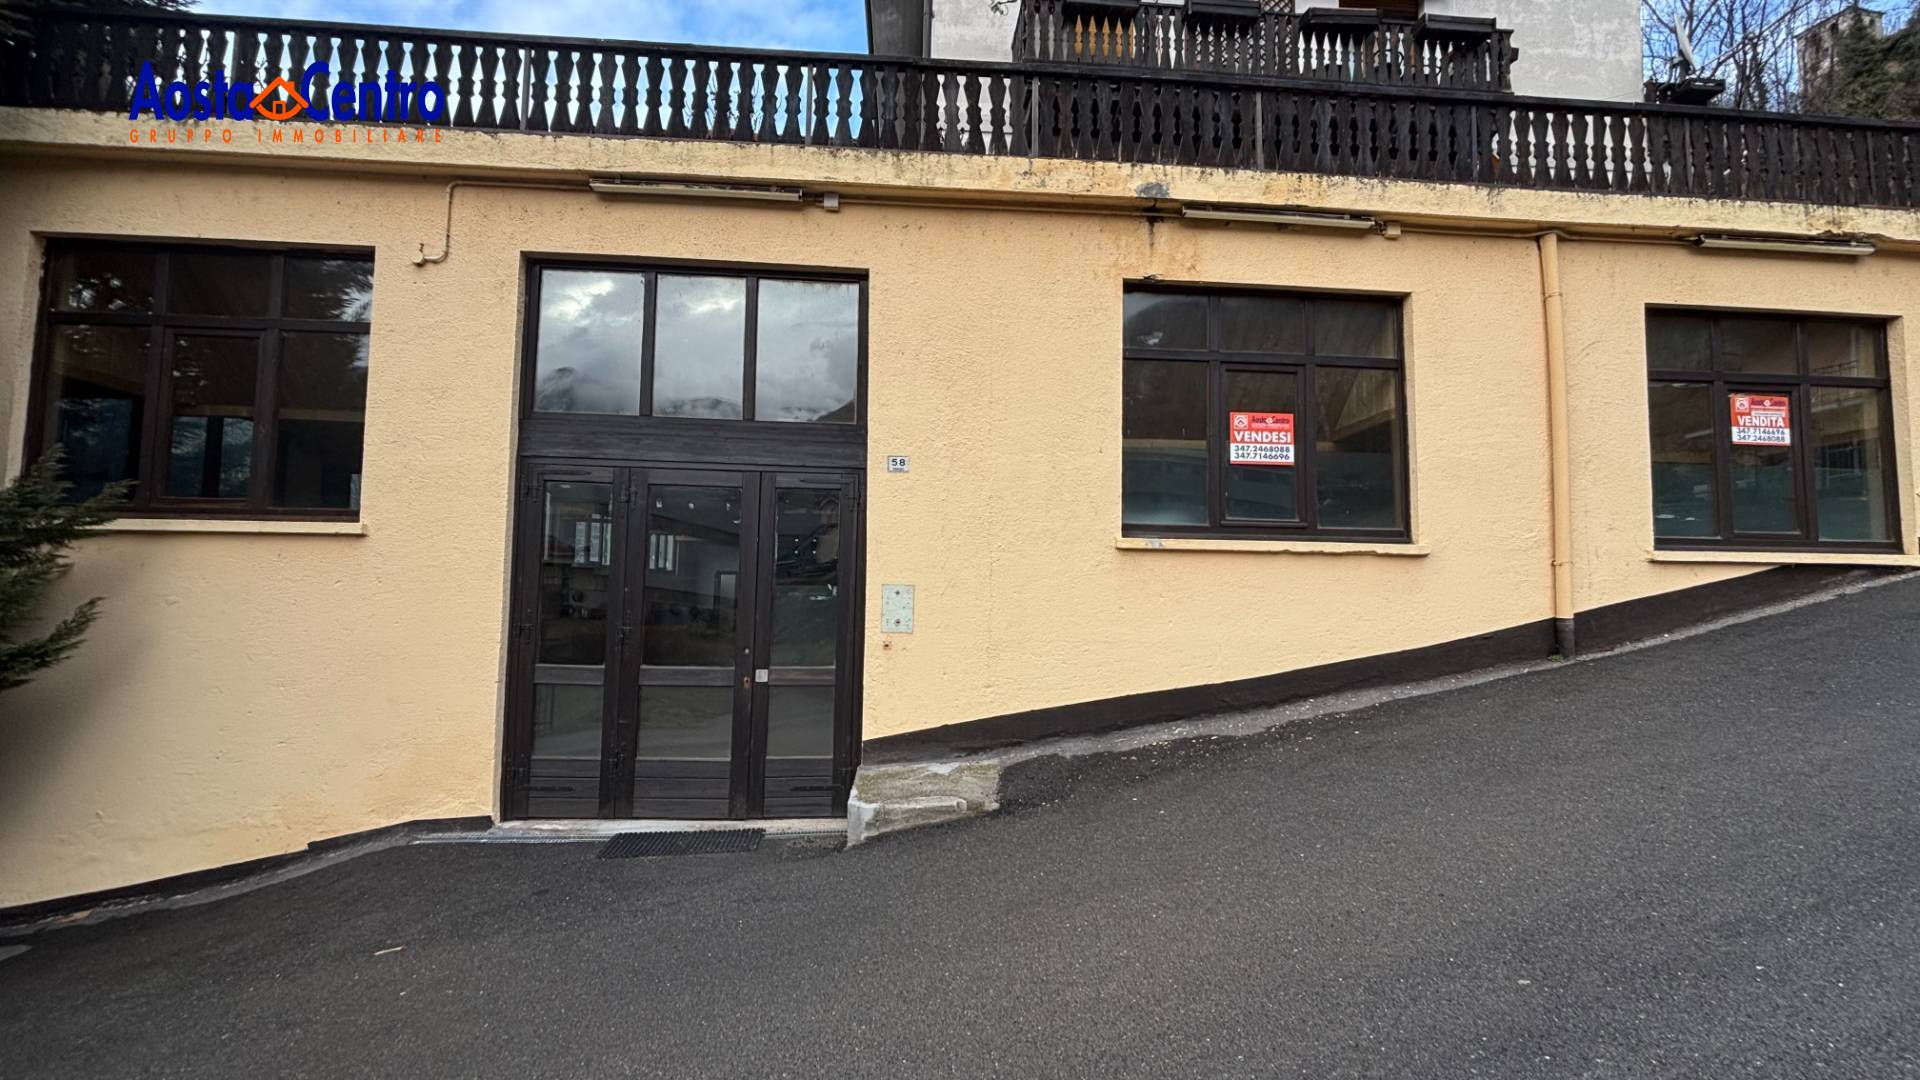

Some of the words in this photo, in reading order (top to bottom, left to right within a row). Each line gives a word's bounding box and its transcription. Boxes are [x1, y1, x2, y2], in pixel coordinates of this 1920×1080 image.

[1737, 416, 1785, 427] VENDITA
[1233, 431, 1291, 443] VENDESI
[1234, 445, 1290, 453] 347.2468088
[891, 458, 906, 466] 58
